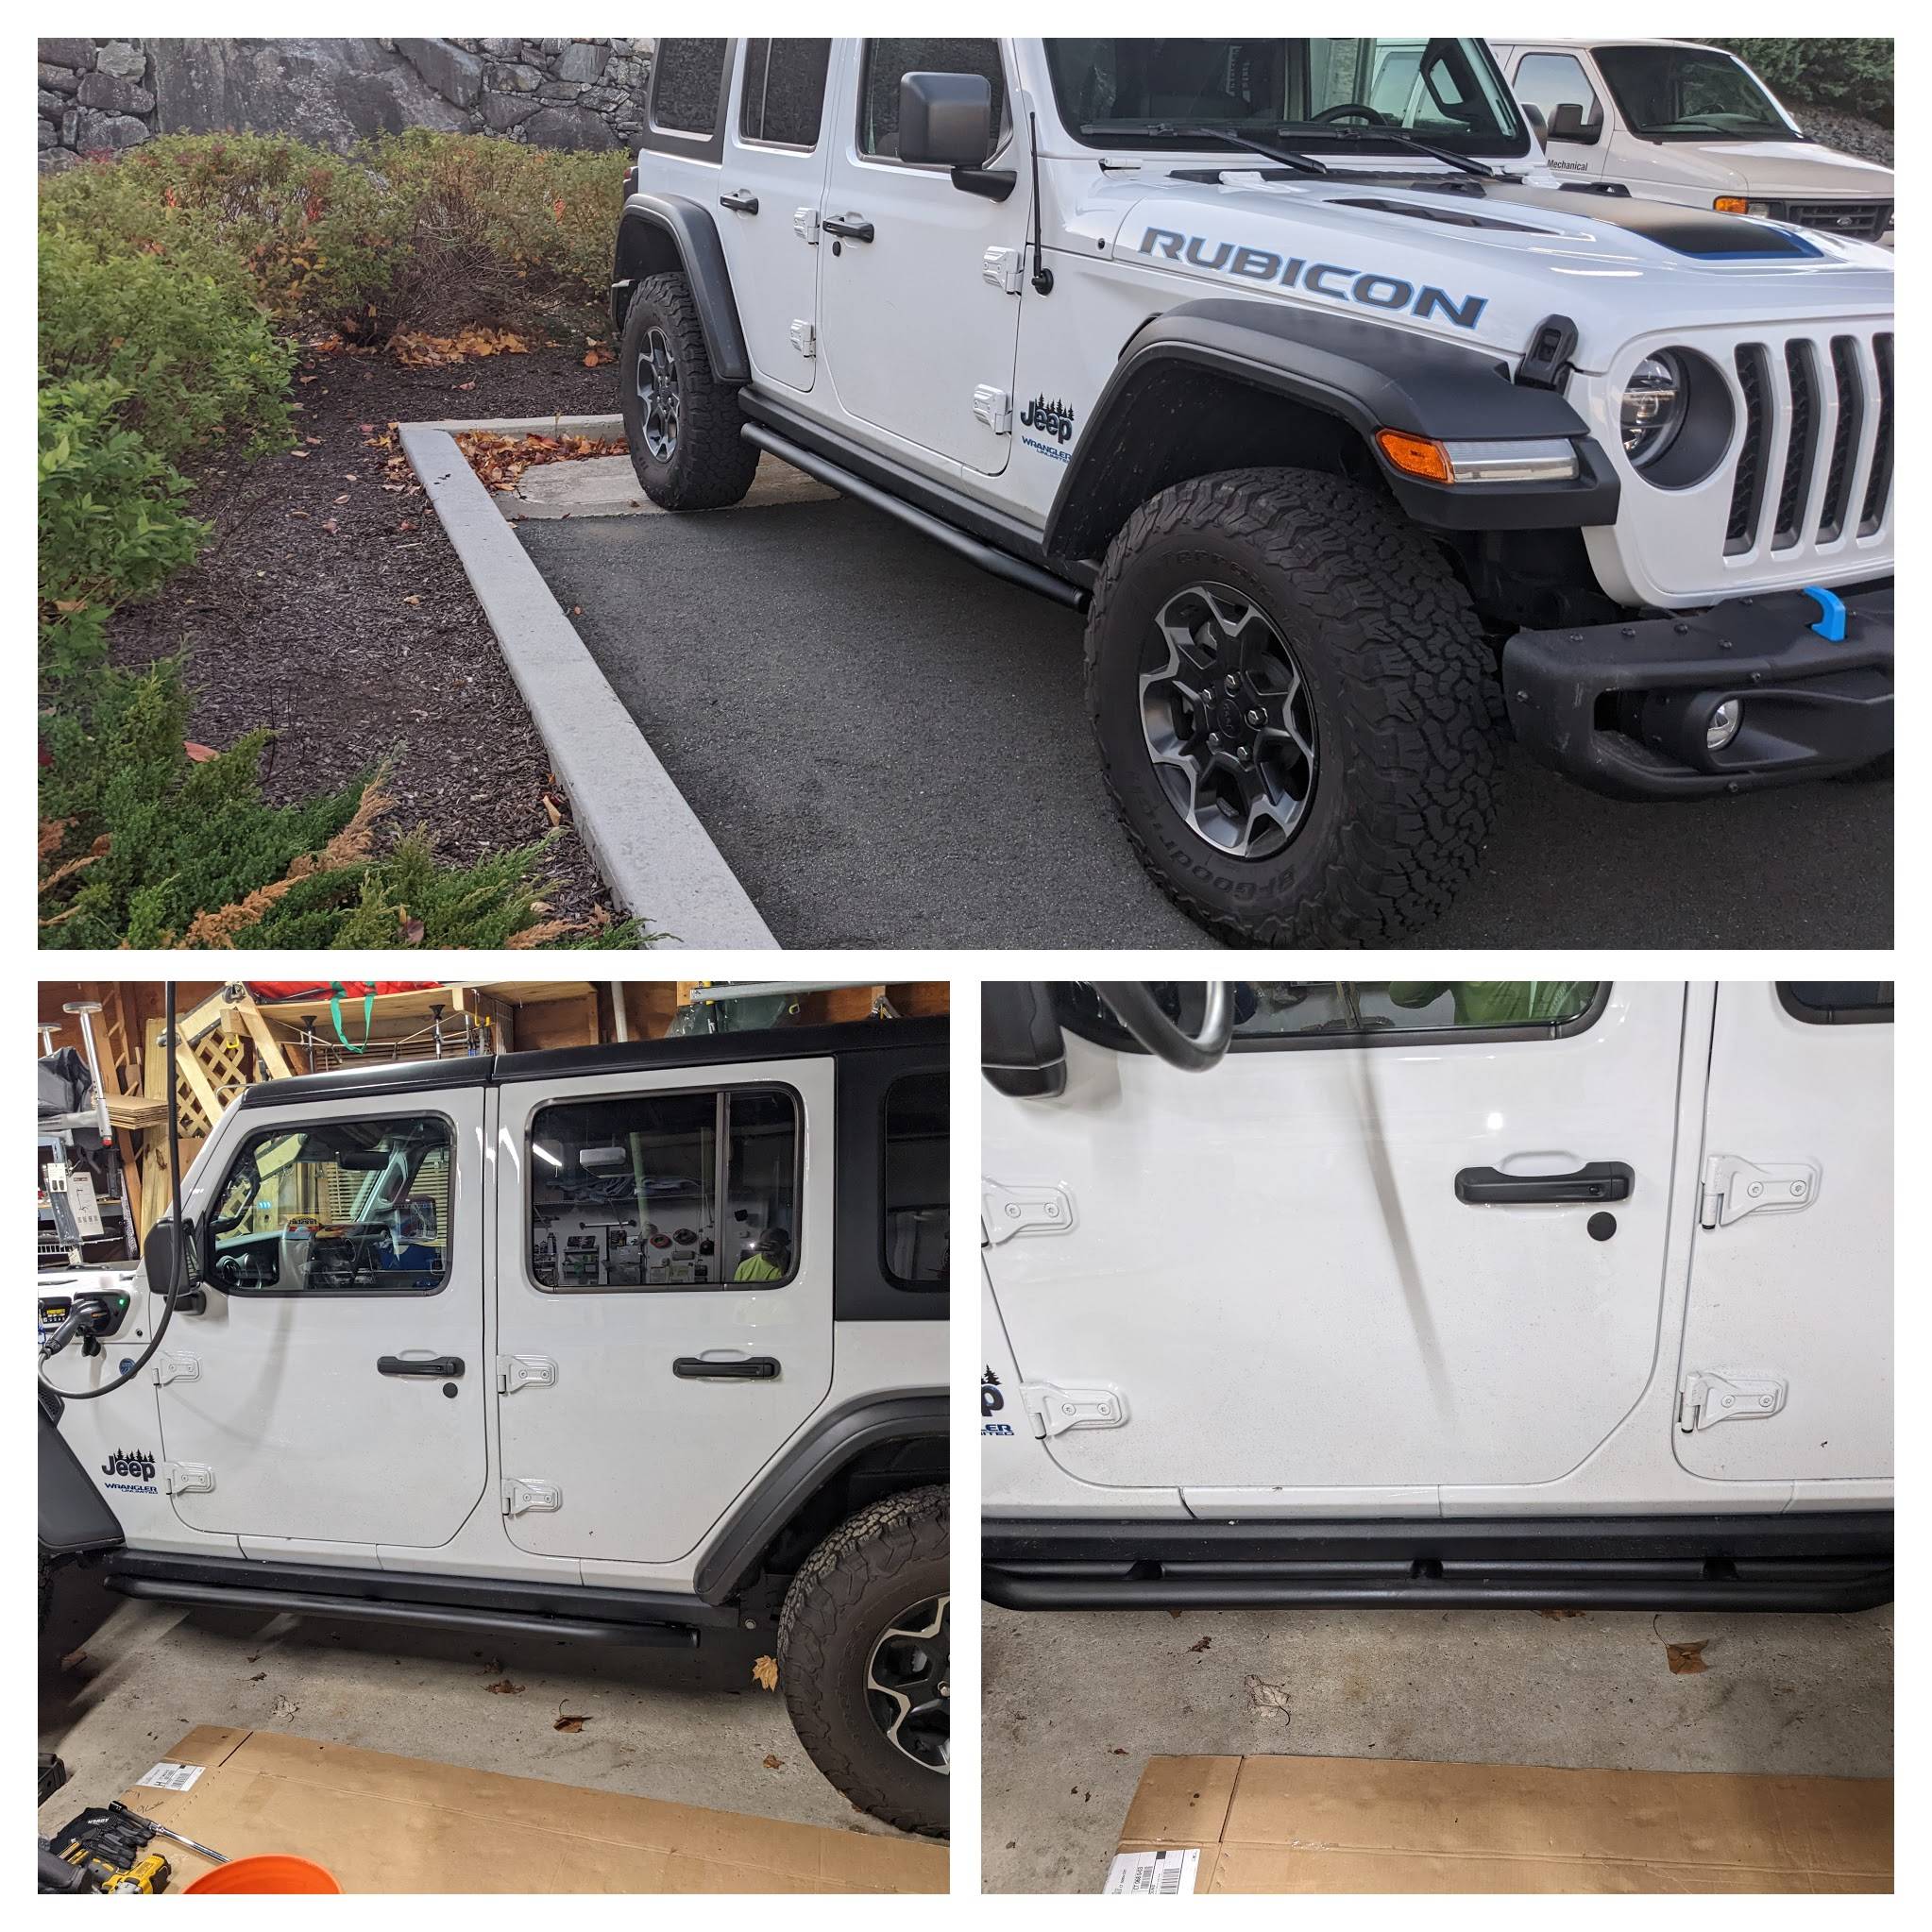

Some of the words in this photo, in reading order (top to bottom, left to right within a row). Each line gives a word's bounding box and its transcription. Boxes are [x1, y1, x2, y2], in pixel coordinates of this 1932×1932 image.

[1547, 159, 1588, 172] Mechanical
[1139, 226, 1489, 330] RUBICON
[1020, 399, 1073, 445] Jeep
[1021, 434, 1073, 461] WRANGLER
[101, 1455, 156, 1483] Jeep
[104, 1482, 157, 1492] WRANGLER
